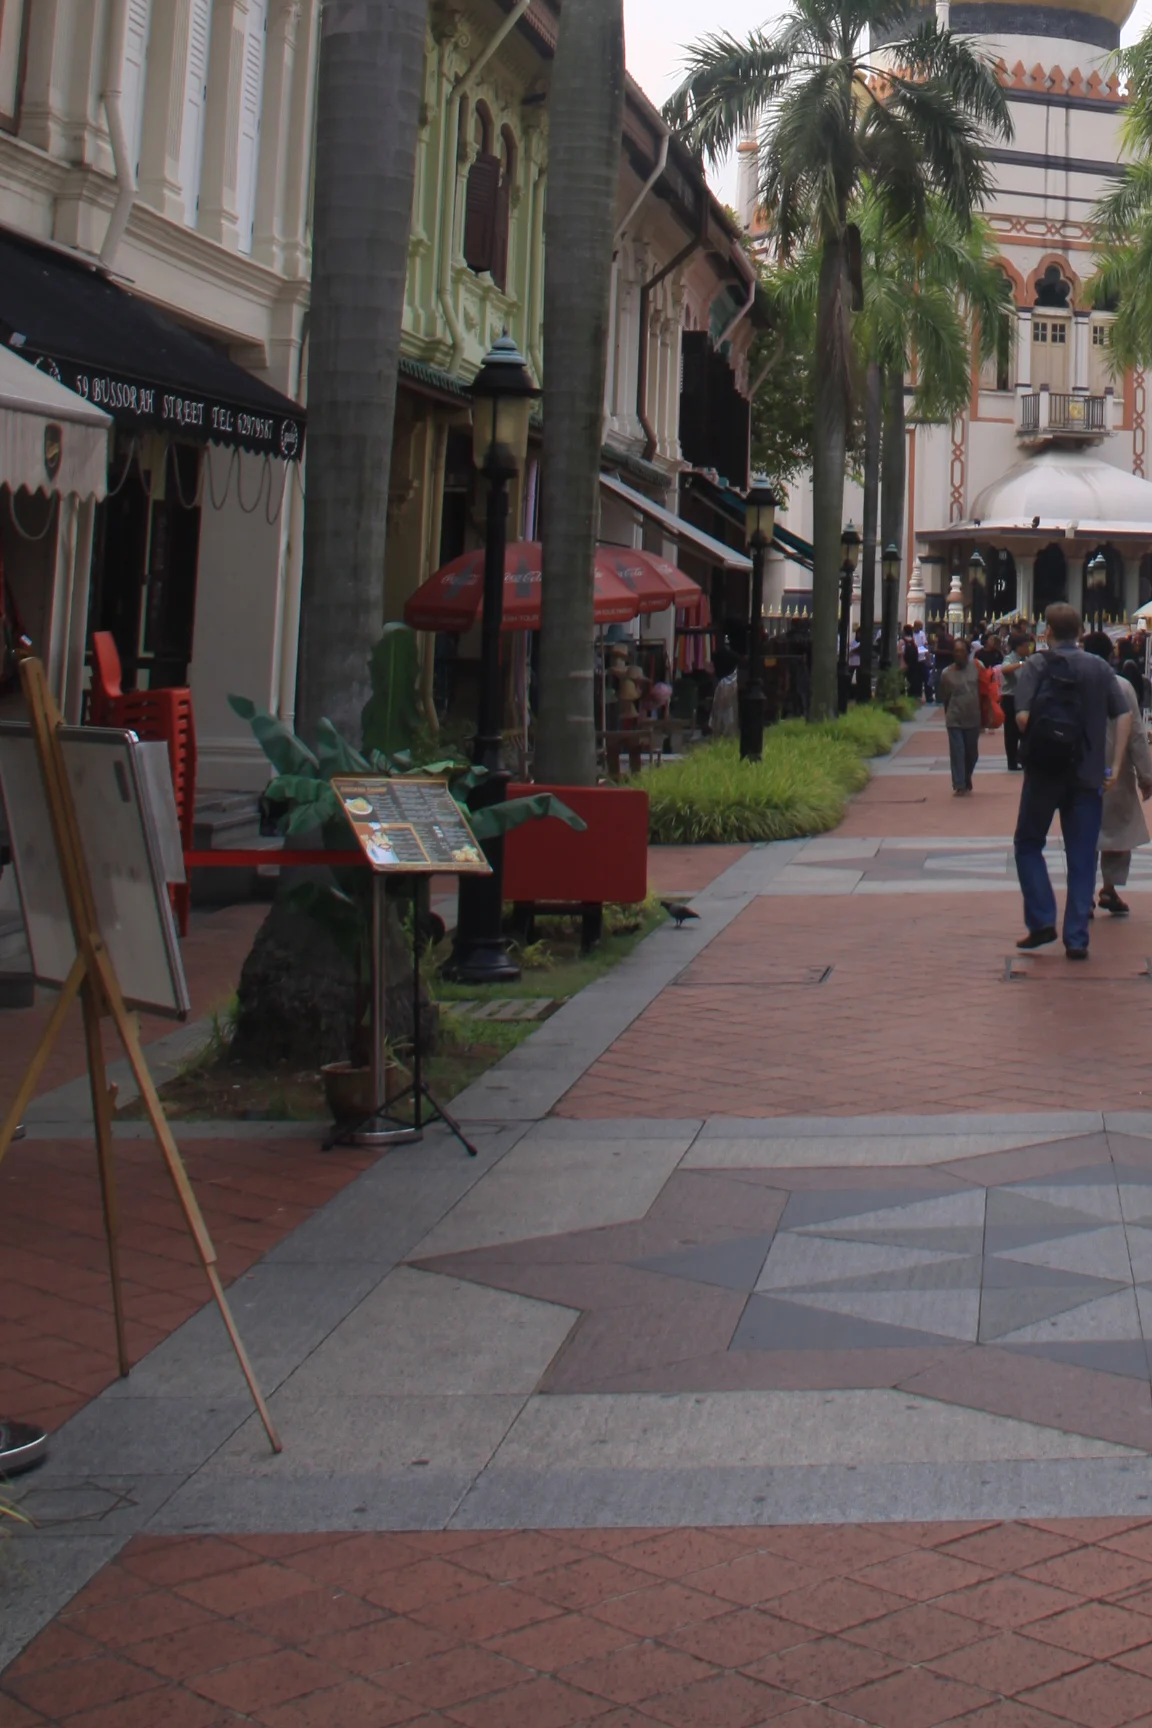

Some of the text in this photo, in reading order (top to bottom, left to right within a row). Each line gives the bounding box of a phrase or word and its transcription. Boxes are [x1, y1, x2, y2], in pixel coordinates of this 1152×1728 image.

[76, 375, 89, 399] 59
[92, 377, 156, 415] BUSSORAH
[163, 394, 205, 426] STREET
